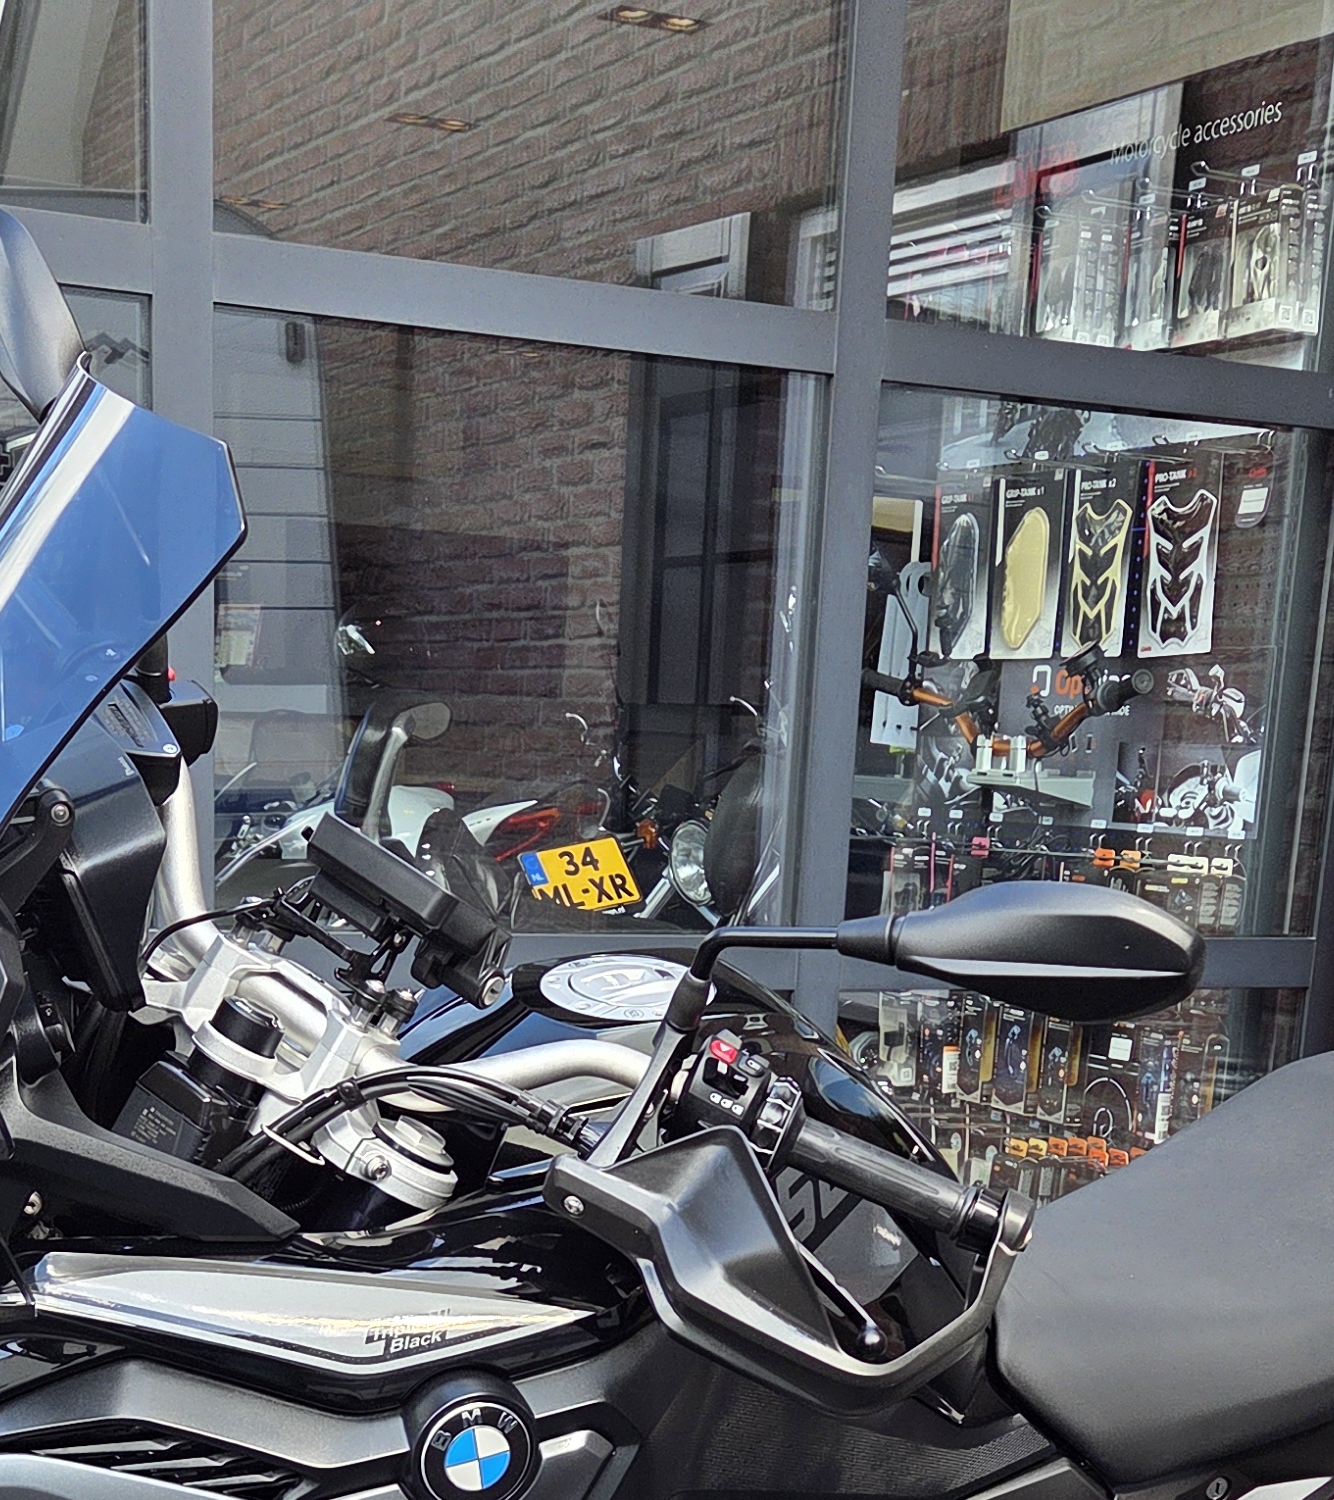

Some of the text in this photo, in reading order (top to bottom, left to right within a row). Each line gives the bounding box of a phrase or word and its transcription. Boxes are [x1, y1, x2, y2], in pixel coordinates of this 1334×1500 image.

[1110, 99, 1283, 166] Motorcycle accessories
[558, 846, 600, 876] 34
[531, 872, 545, 882] NL
[390, 1329, 443, 1354] Black
[431, 1408, 518, 1452] BMW
